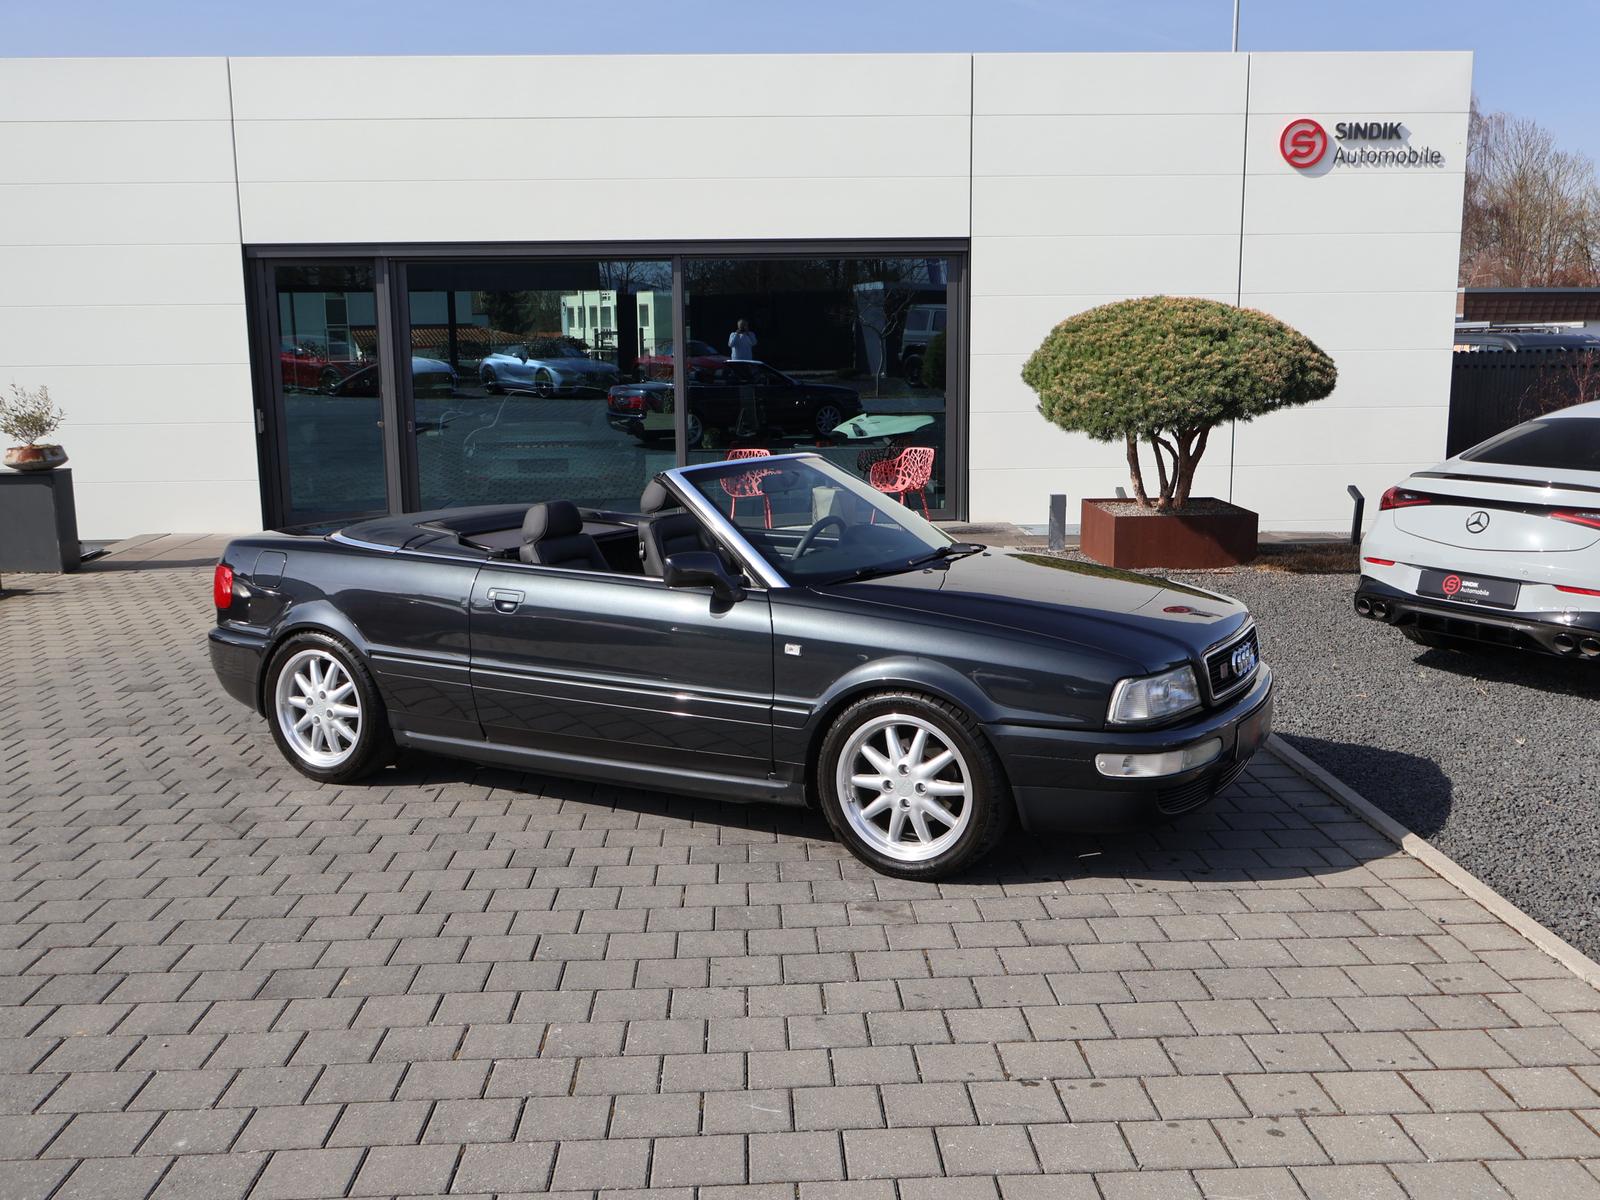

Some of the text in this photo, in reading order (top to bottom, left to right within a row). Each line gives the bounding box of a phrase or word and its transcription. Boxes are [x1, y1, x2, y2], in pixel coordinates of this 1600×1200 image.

[1334, 122, 1402, 140] SINDIK
[1333, 146, 1441, 164] Automobile
[1460, 587, 1489, 596] Automobile
